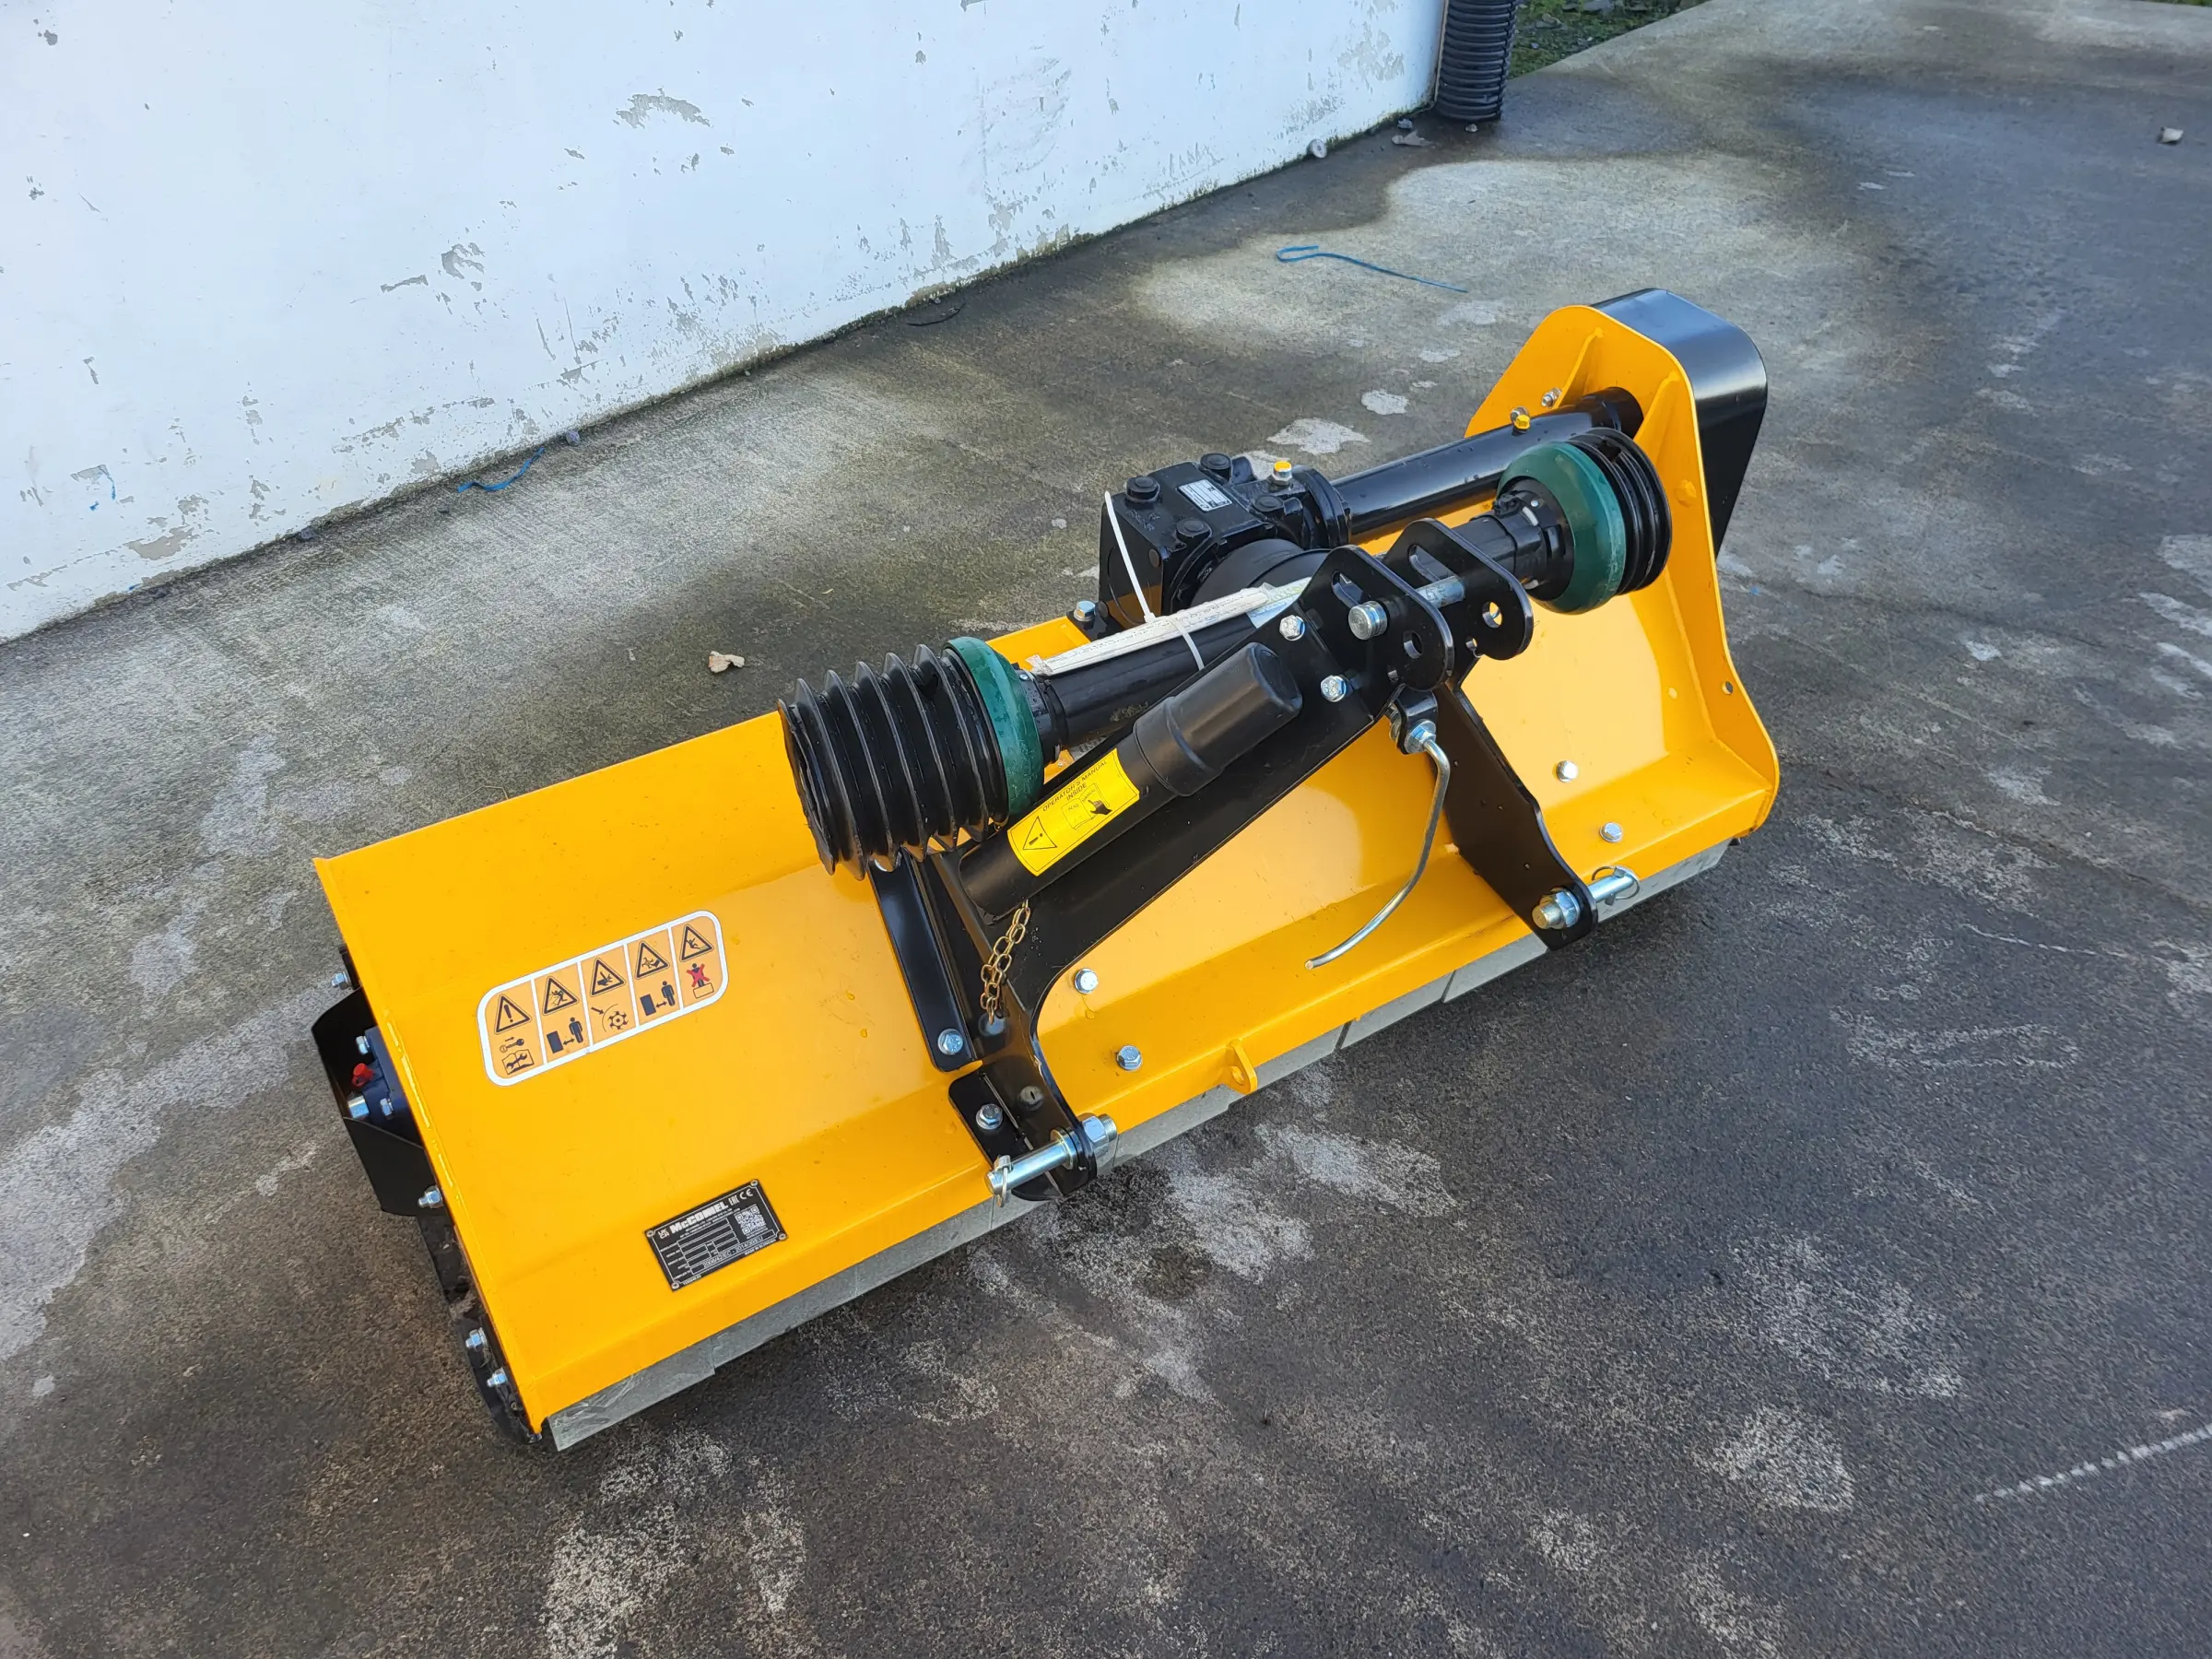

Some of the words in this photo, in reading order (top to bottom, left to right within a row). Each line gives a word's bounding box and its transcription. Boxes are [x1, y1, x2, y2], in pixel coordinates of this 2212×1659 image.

[1042, 781, 1081, 812] OPERATOR'S
[1081, 760, 1107, 782] MANUAL
[1066, 783, 1088, 801] INSIDE
